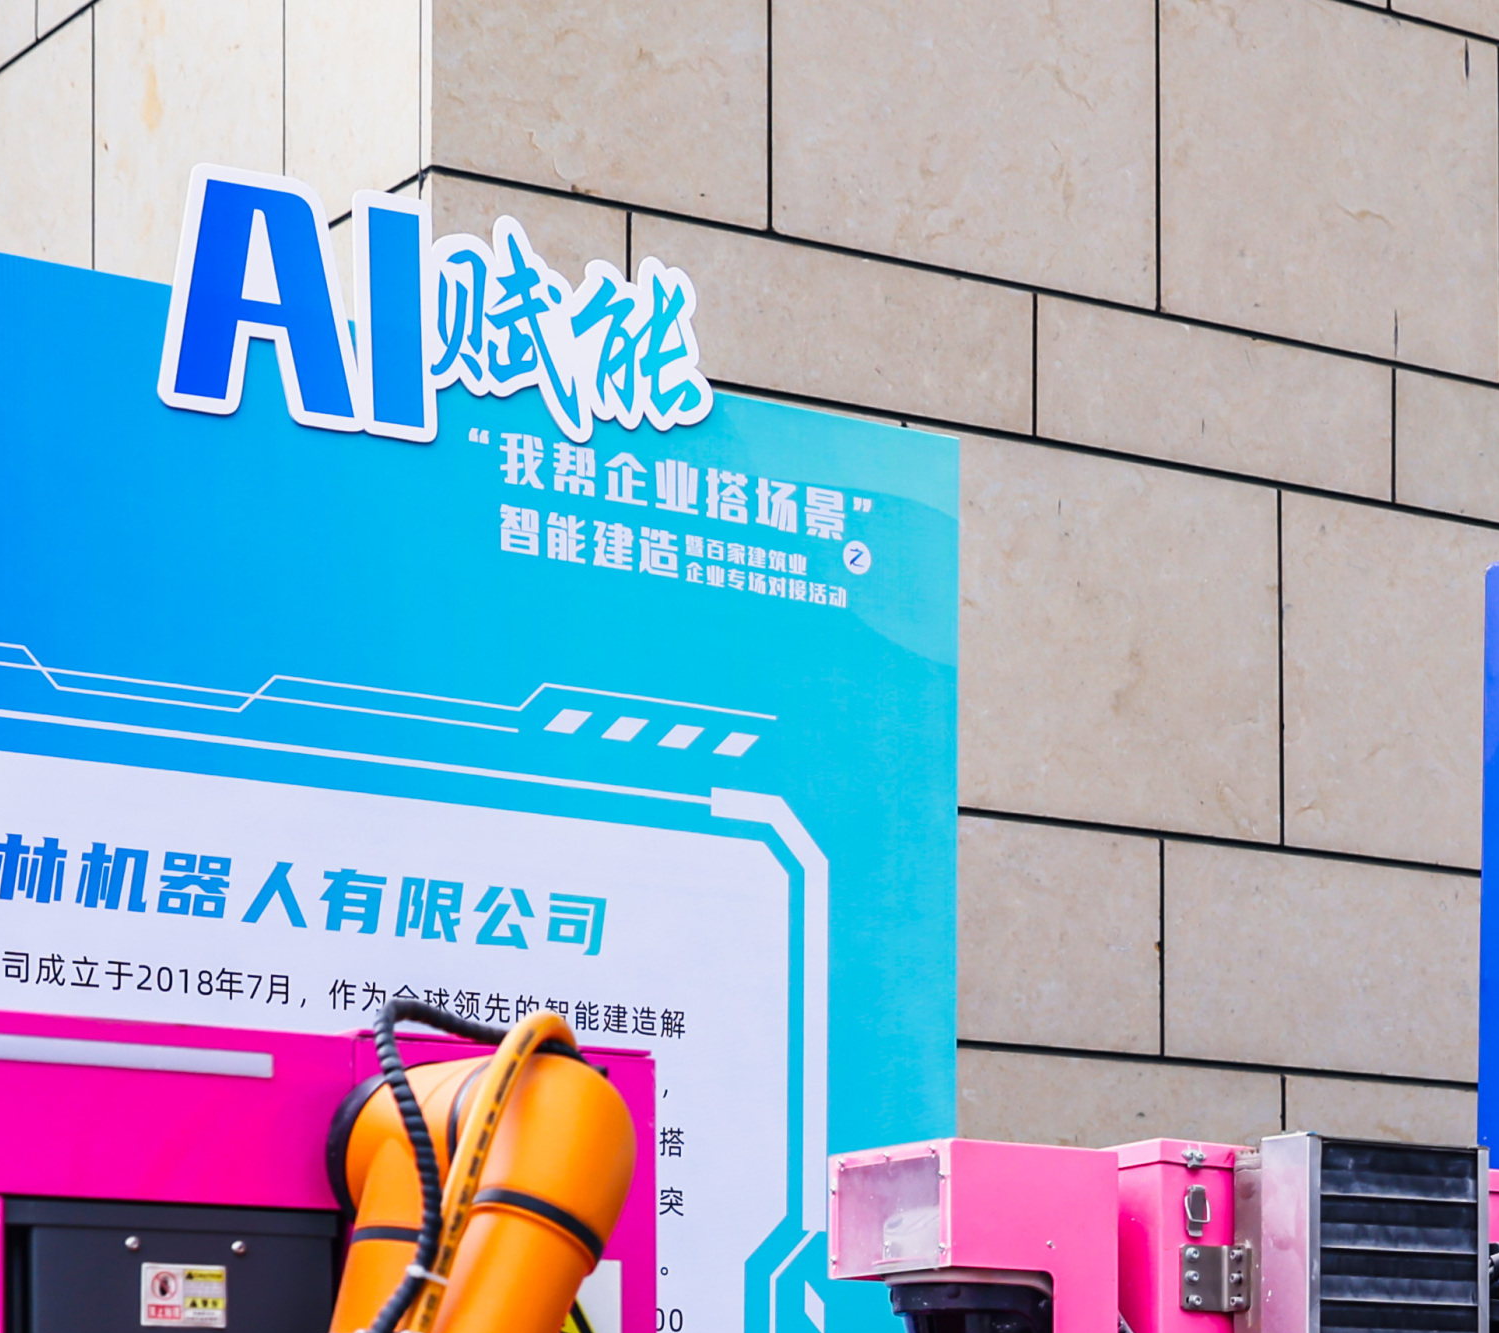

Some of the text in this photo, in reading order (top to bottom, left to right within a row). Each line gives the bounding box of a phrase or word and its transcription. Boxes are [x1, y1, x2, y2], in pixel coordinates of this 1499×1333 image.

[468, 427, 873, 542] “我帮企业搭场景”
[499, 505, 680, 580] 智能建造
[685, 533, 808, 577] 暨百家建筑业
[685, 560, 848, 609] 企业专场对接活动
[659, 1127, 685, 1158] 搭
[659, 1186, 685, 1217] 突
